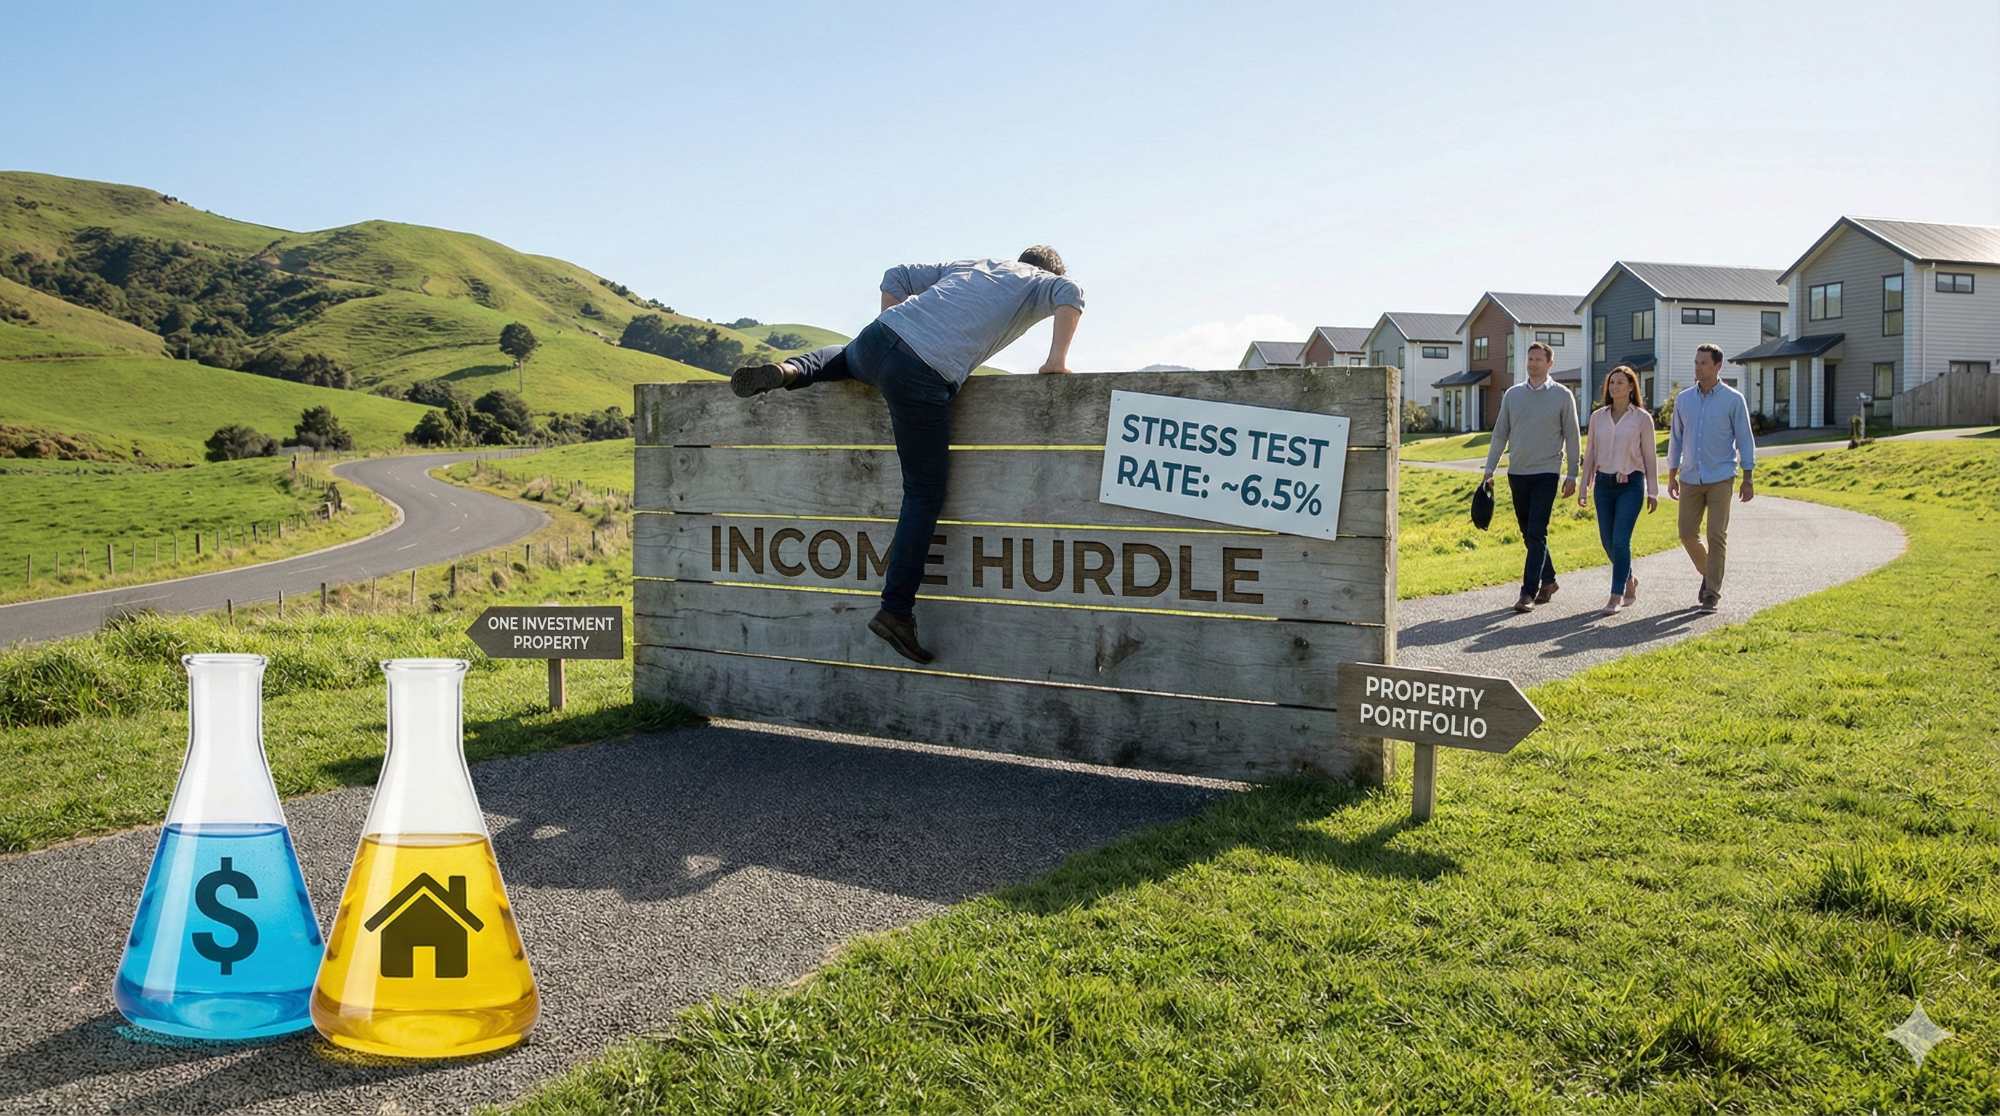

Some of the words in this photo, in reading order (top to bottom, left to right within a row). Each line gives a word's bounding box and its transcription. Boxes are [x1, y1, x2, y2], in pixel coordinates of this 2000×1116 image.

[1121, 414, 1237, 456] STRESS
[1248, 430, 1329, 468] TEST
[1117, 455, 1210, 498] RATE:
[1221, 474, 1322, 516] ~6.5%
[972, 536, 1264, 604] HURDLE
[488, 616, 518, 631] ONE
[522, 616, 615, 631] INVESTMENT
[513, 635, 589, 650] PROPERTY
[1366, 676, 1485, 710] PROPERTY
[1360, 703, 1487, 739] PORTFOLIO
